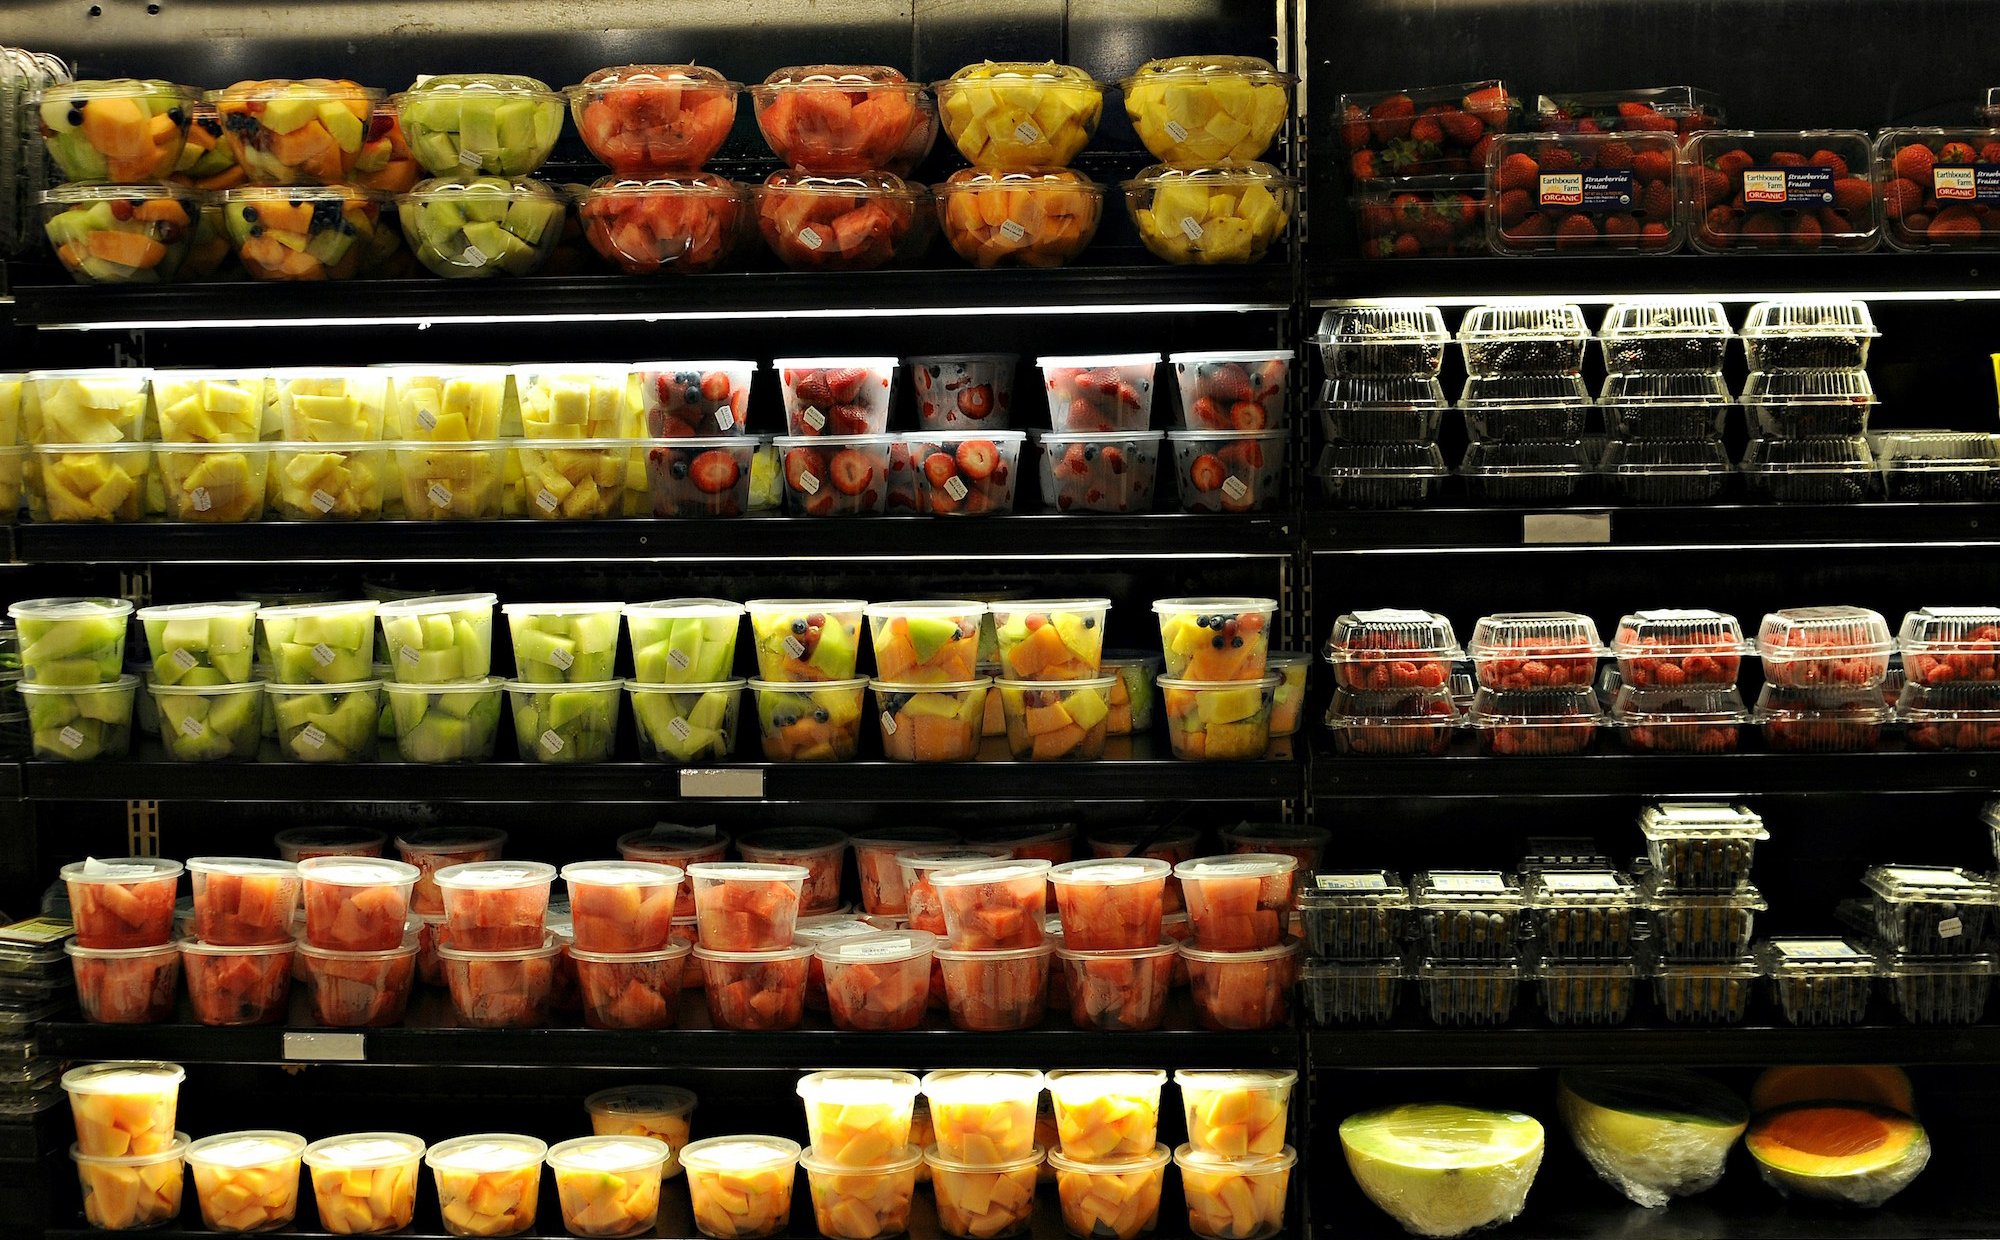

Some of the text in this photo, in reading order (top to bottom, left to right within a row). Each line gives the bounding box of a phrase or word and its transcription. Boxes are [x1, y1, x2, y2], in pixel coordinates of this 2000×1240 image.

[1543, 177, 1579, 185] Earthbound
[1747, 174, 1783, 182] Earthbound
[1749, 191, 1783, 199] ORGANIC
[1938, 188, 1972, 196] ORGANIC
[1543, 194, 1579, 202] ORGANIC
